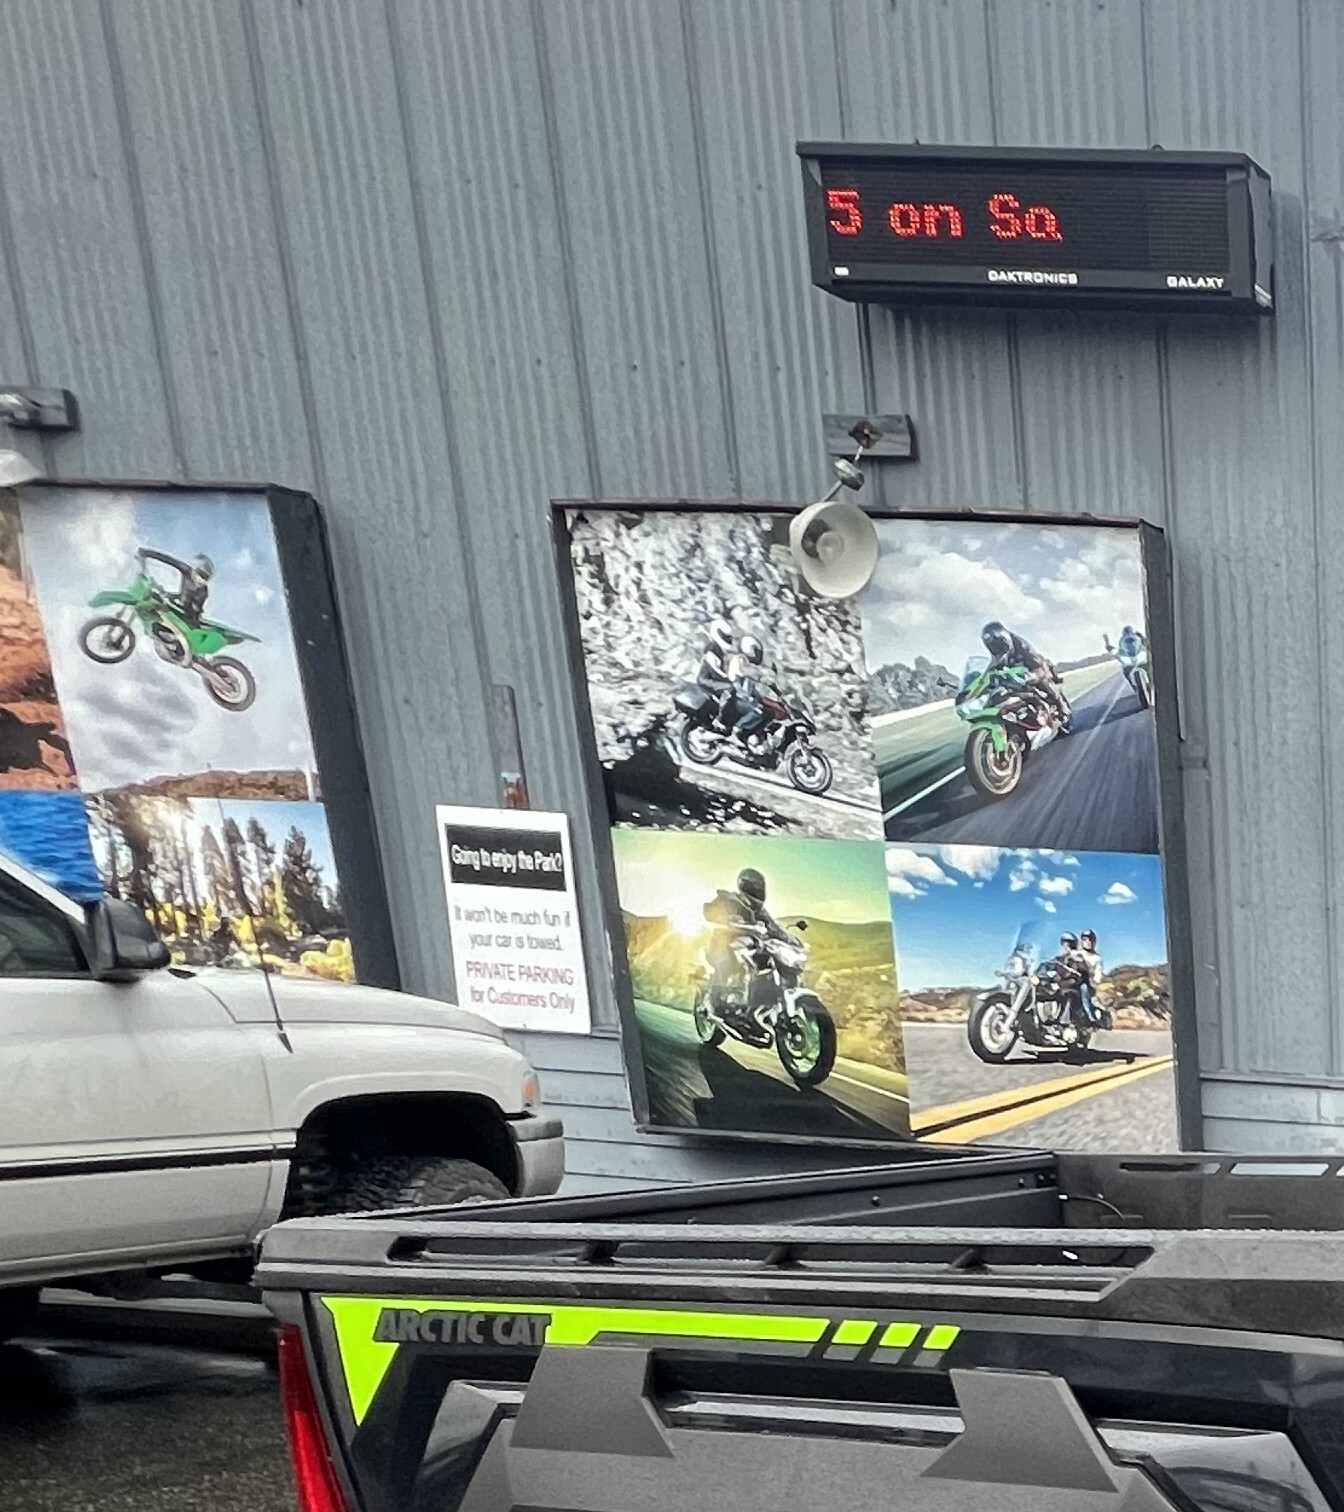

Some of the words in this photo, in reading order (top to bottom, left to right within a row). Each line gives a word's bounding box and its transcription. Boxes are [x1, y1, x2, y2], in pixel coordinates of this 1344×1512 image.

[827, 189, 863, 236] 5
[888, 203, 962, 238] on
[989, 193, 1063, 242] Sa
[1166, 276, 1224, 289] GALAXY
[451, 844, 480, 871] Going
[480, 847, 491, 867] to
[492, 847, 517, 873] enjoy
[517, 850, 534, 870] the
[534, 850, 562, 872] Park?
[454, 904, 462, 921] It
[464, 906, 493, 923] won't
[494, 908, 508, 924] be
[511, 910, 540, 925] much
[543, 909, 561, 927] fun
[563, 910, 571, 928] if
[469, 934, 492, 950] your
[495, 934, 512, 948] car
[515, 932, 525, 949] is
[527, 934, 564, 952] towed.
[466, 960, 516, 981] PRIVATE
[518, 964, 574, 986] PARKING
[470, 986, 485, 1003] for
[487, 986, 547, 1008] Customers
[549, 992, 575, 1014] Only
[375, 1308, 486, 1344] ARCTIC
[492, 1314, 550, 1346] CAT
